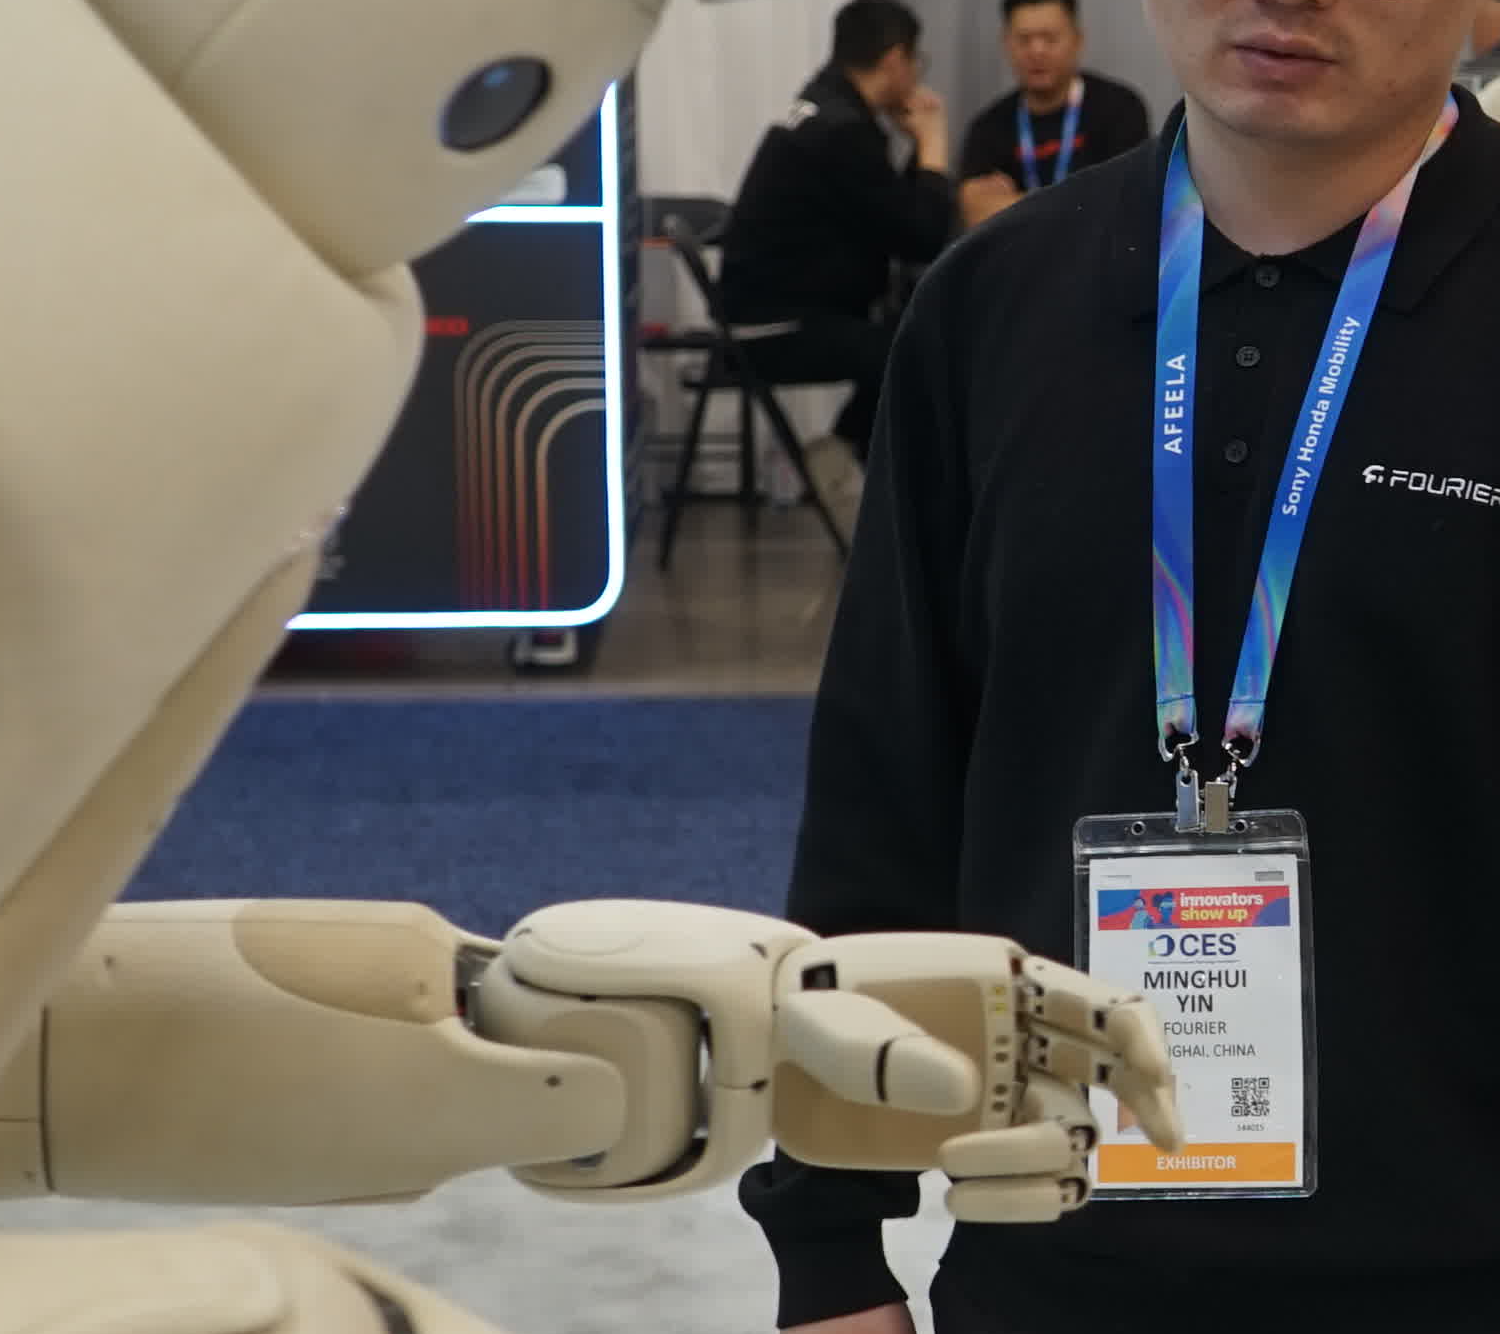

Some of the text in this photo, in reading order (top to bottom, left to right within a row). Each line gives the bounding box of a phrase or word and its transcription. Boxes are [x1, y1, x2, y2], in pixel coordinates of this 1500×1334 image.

[1163, 353, 1188, 455] AFEELA
[1282, 314, 1362, 517] Sony Honda Mobility
[1179, 892, 1265, 908] innovators
[1180, 907, 1249, 923] show up
[1178, 933, 1237, 956] CES
[1176, 994, 1214, 1013] YIN
[1163, 1021, 1227, 1036] FOURIER
[1213, 1043, 1257, 1058] CHINA
[1156, 1154, 1238, 1171] EXHIBITOR
